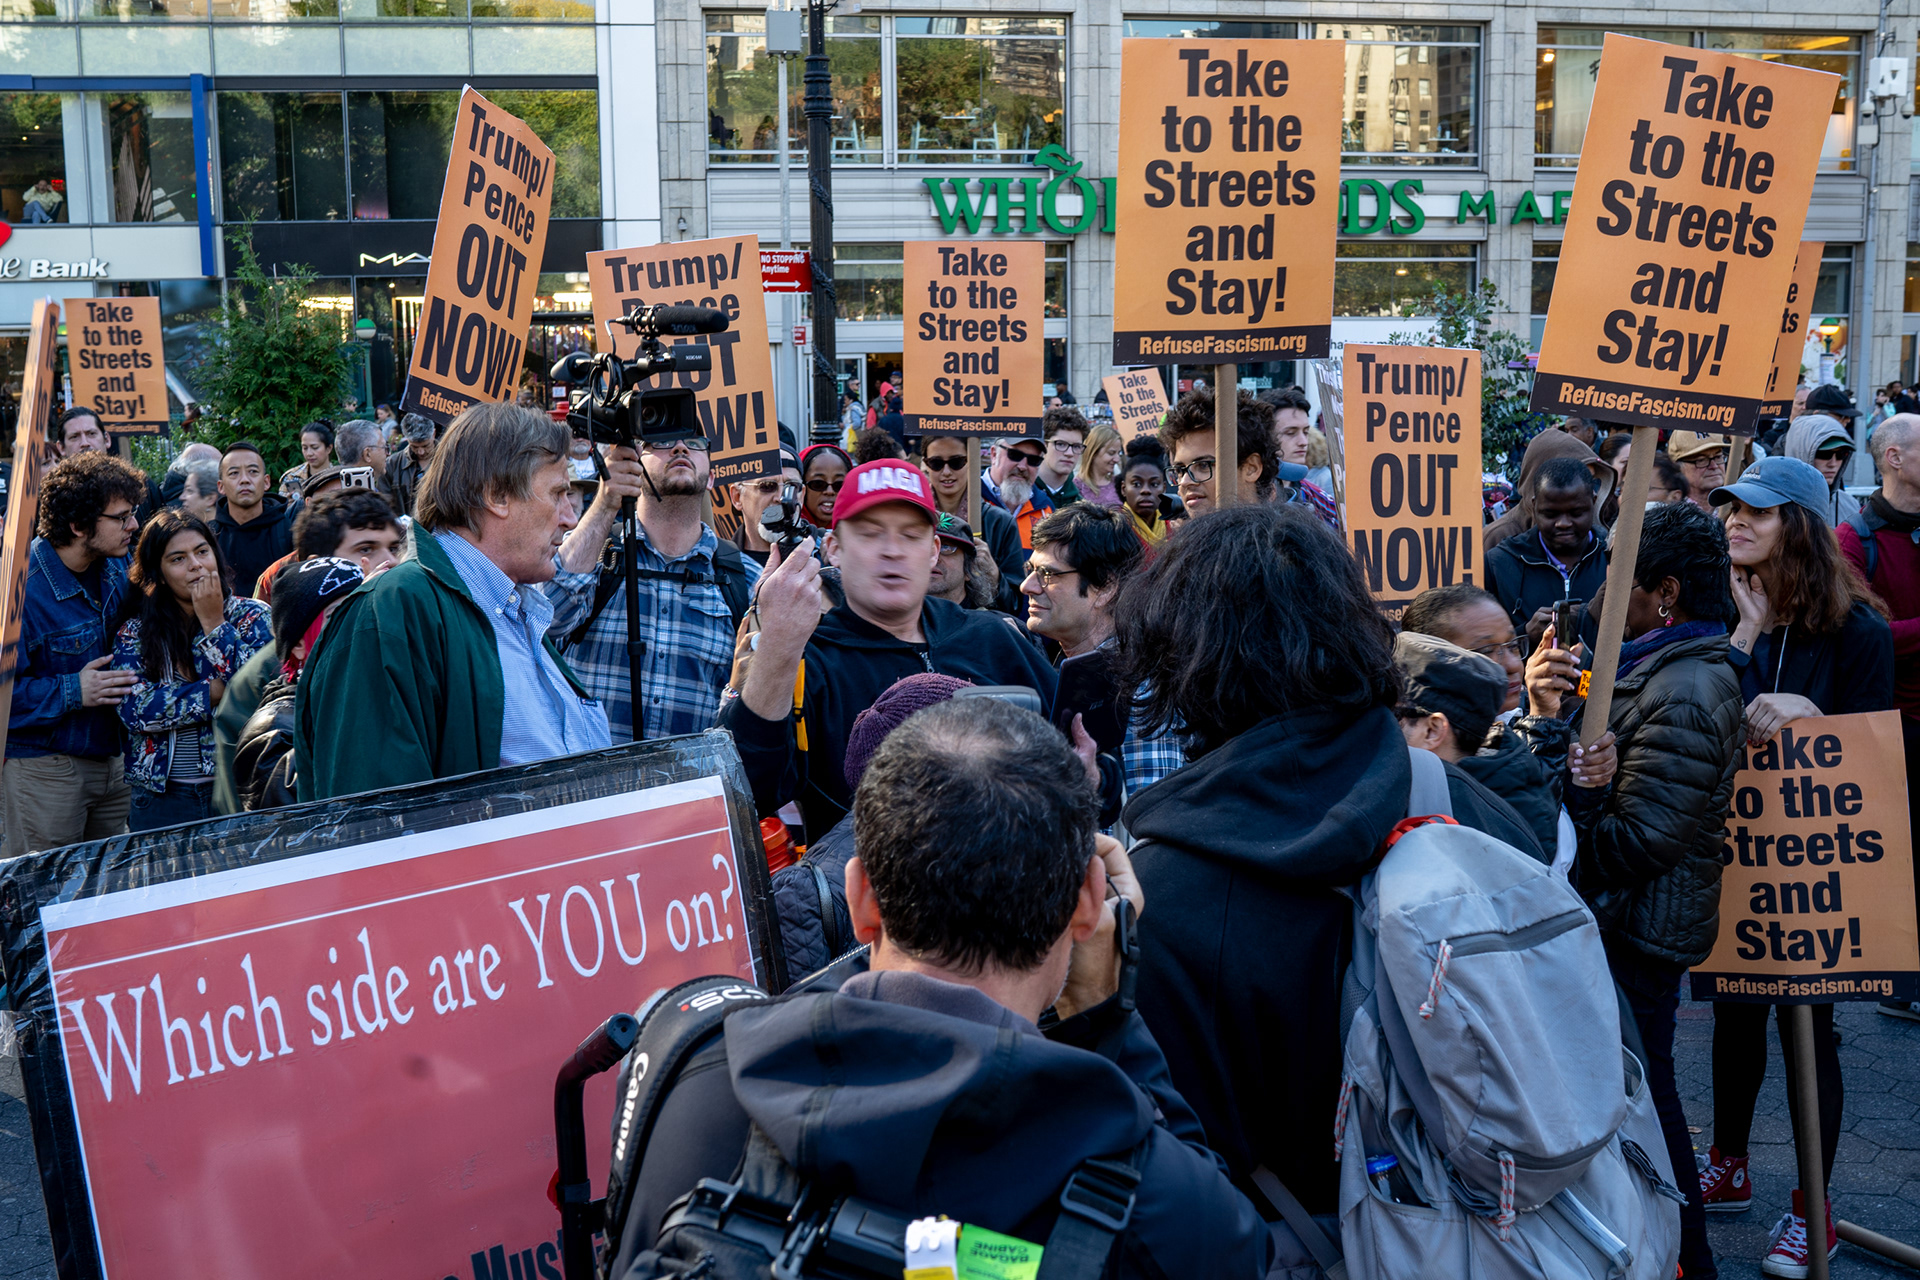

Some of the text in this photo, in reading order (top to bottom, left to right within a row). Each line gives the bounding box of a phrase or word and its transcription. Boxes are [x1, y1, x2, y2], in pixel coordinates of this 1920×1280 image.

[1179, 49, 1289, 98] Take
[1661, 55, 1774, 130] Take
[1161, 105, 1301, 153] to the
[469, 102, 550, 200] Trump/
[1629, 118, 1774, 194] to the
[463, 160, 536, 245] Pence
[1144, 159, 1316, 209] Streets
[1185, 213, 1275, 262] and
[1596, 179, 1777, 258] Streets
[29, 258, 109, 279] Bank
[457, 223, 527, 321] OUT
[605, 242, 743, 294] Trump/
[760, 253, 805, 264] NO STOPPING
[761, 264, 790, 275] Anytime
[938, 247, 1008, 276] Take
[928, 280, 1018, 310] to the
[1165, 267, 1287, 324] Stay!
[1630, 261, 1728, 314] and
[86, 302, 133, 323] Take
[918, 312, 1028, 343] Streets
[83, 326, 142, 346] to the
[420, 295, 522, 400] NOW!
[1139, 334, 1308, 357] RefuseFascism.org
[1597, 309, 1730, 385] Stay!
[79, 349, 153, 369] Streets
[943, 346, 1000, 375] and
[1357, 353, 1469, 405] Trump/
[97, 372, 136, 392] and
[933, 377, 1009, 414] Stay!
[1118, 374, 1148, 389] Take
[1119, 388, 1156, 404] to the
[94, 395, 146, 419] Stay!
[1120, 401, 1164, 419] Streets
[1136, 416, 1159, 432] and
[1366, 402, 1461, 443] Pence
[1558, 381, 1736, 426] RefuseFascism.org
[919, 418, 1027, 434] RefuseFascism.org
[1370, 453, 1458, 518] OUT
[1354, 526, 1473, 593] NOW!
[1738, 728, 1842, 771] ake
[1727, 776, 1863, 819] o the
[1750, 871, 1842, 914] and
[1736, 917, 1862, 969] Stay!
[66, 853, 734, 1103] Which side are YOU on?
[1716, 977, 1894, 996] RefuseFascism.org
[615, 1052, 649, 1161] Canon
